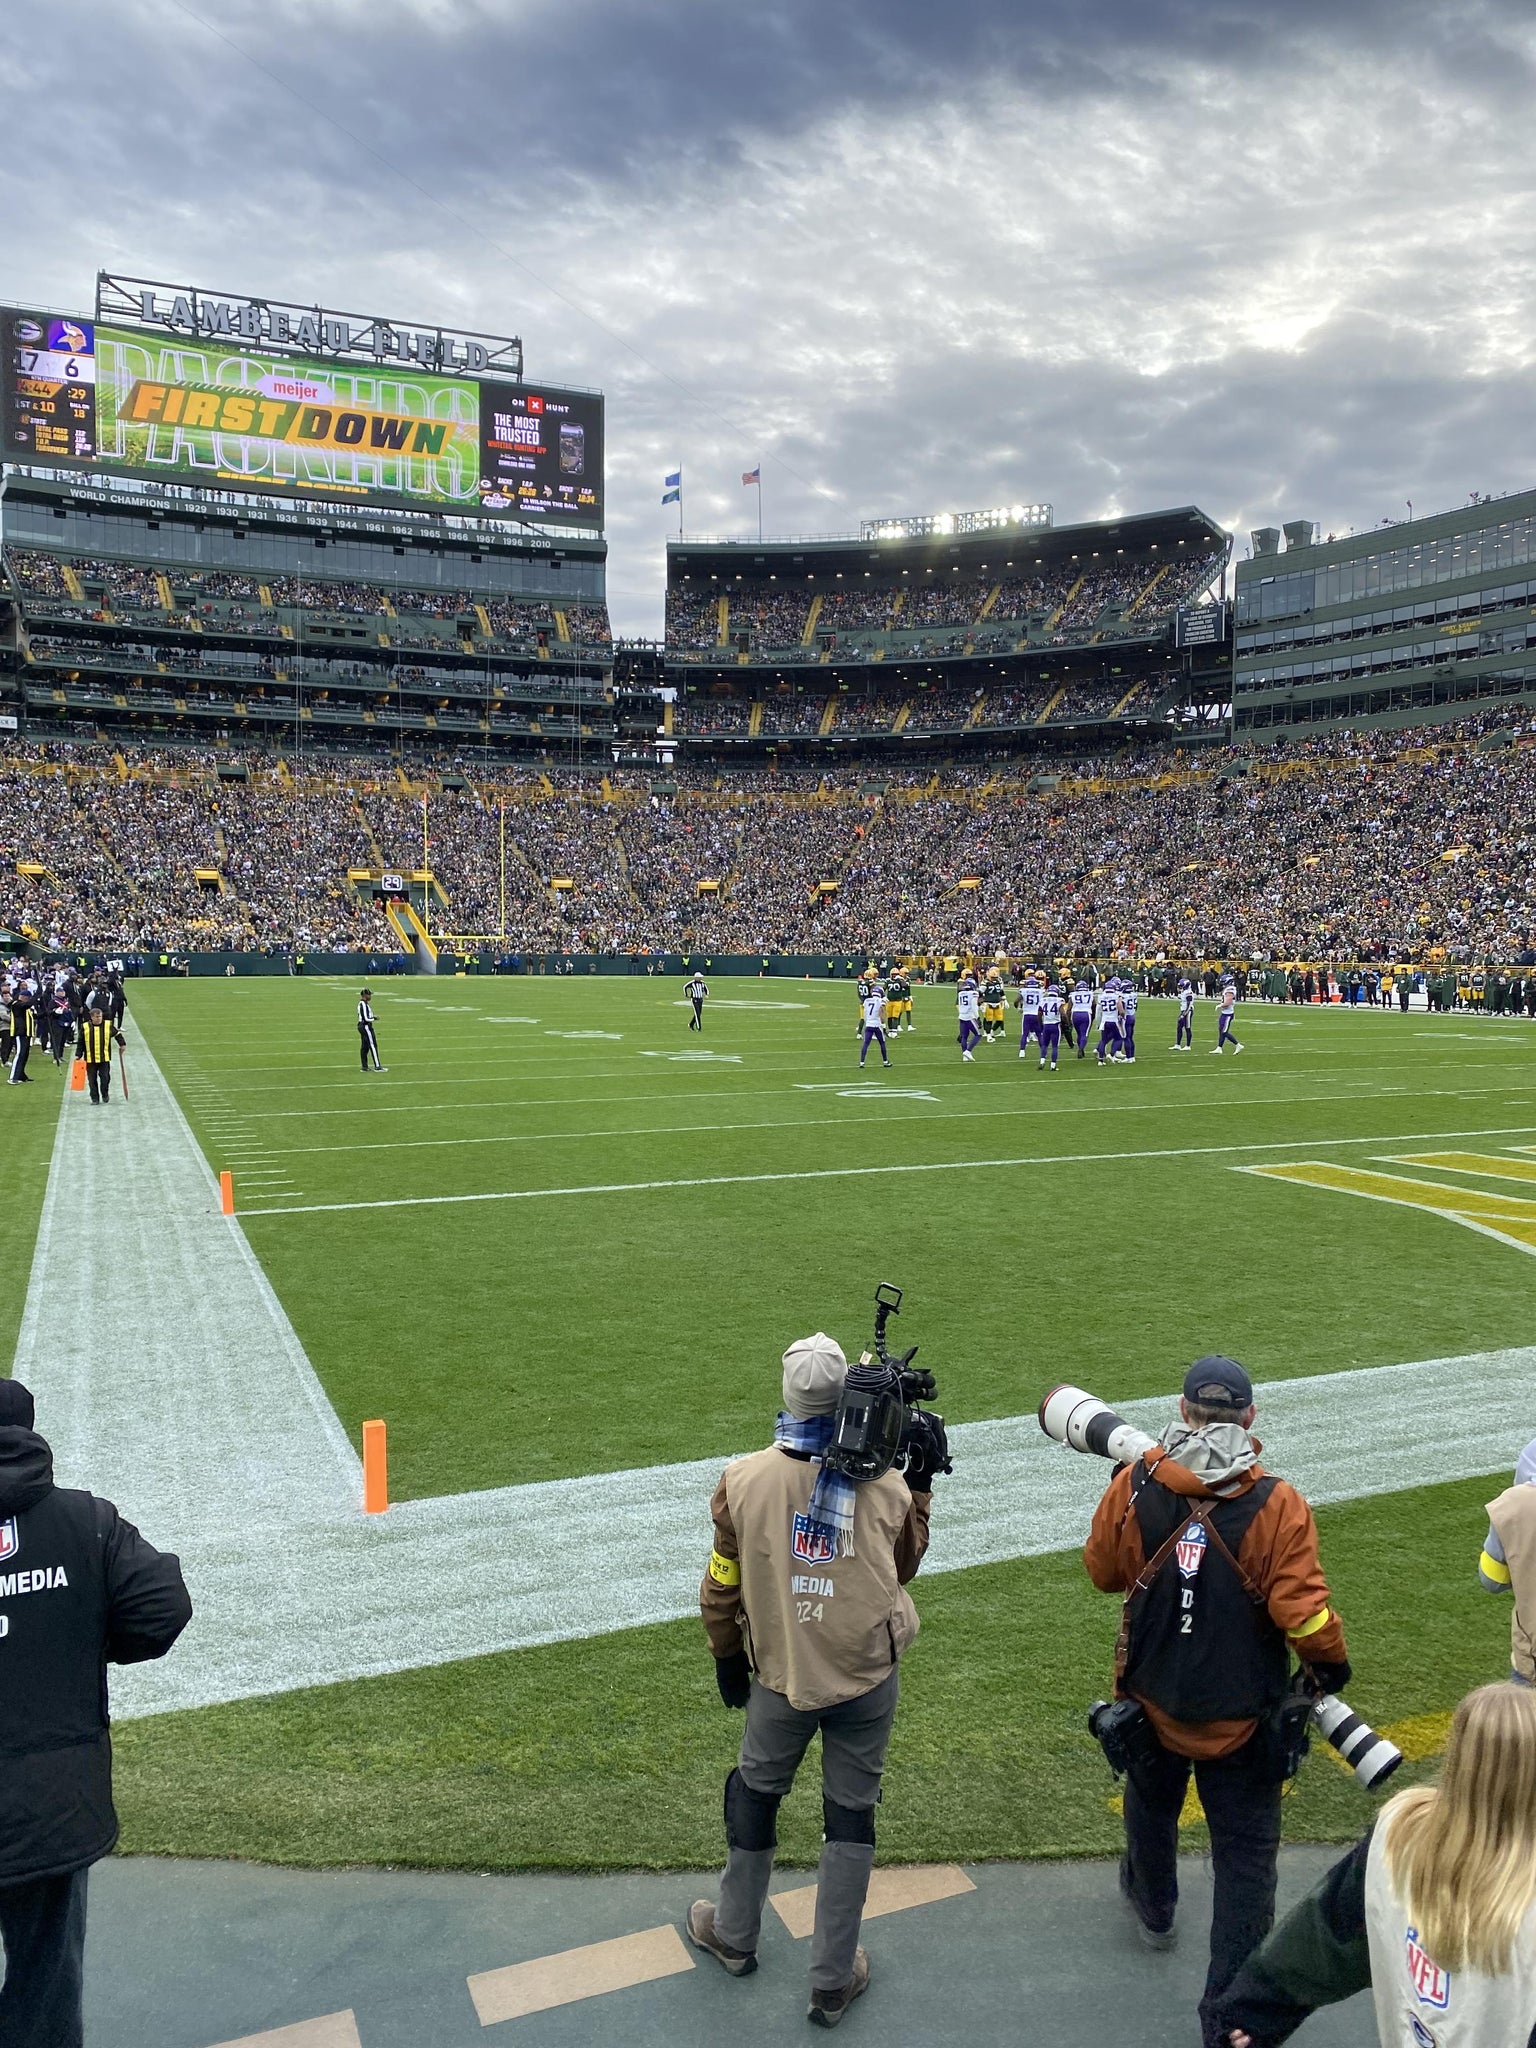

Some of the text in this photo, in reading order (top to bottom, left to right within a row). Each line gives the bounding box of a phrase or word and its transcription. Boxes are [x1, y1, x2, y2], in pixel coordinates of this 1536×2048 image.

[140, 290, 489, 372] LAMBEAU FIELD
[65, 358, 79, 377] 6
[273, 381, 319, 401] meijer
[40, 401, 56, 413] 10
[546, 403, 570, 413] HUNT
[132, 384, 447, 455] FIRST DOWN
[494, 412, 540, 431] THE MOST
[494, 426, 540, 445] TRUSTED
[530, 498, 551, 507] WILSON
[563, 502, 579, 510] BALL
[69, 488, 551, 548] WORLD CHAMPIONS 1929 1930 1931 1936 1939 1944 1961 1962 1965 1966 1967 1996 2010
[384, 877, 400, 889] 29
[888, 983, 901, 991] 70
[1026, 994, 1039, 1005] 61
[1074, 994, 1091, 1004] 97
[1100, 999, 1117, 1012] 22
[868, 1003, 876, 1016] 7
[1042, 1002, 1058, 1016] 44
[796, 1531, 832, 1559] NFL
[0, 1566, 69, 1598] MEDIA
[791, 1575, 834, 1598] MEDIA
[1180, 1613, 1194, 1634] 2
[1408, 1942, 1445, 2001] NFL
